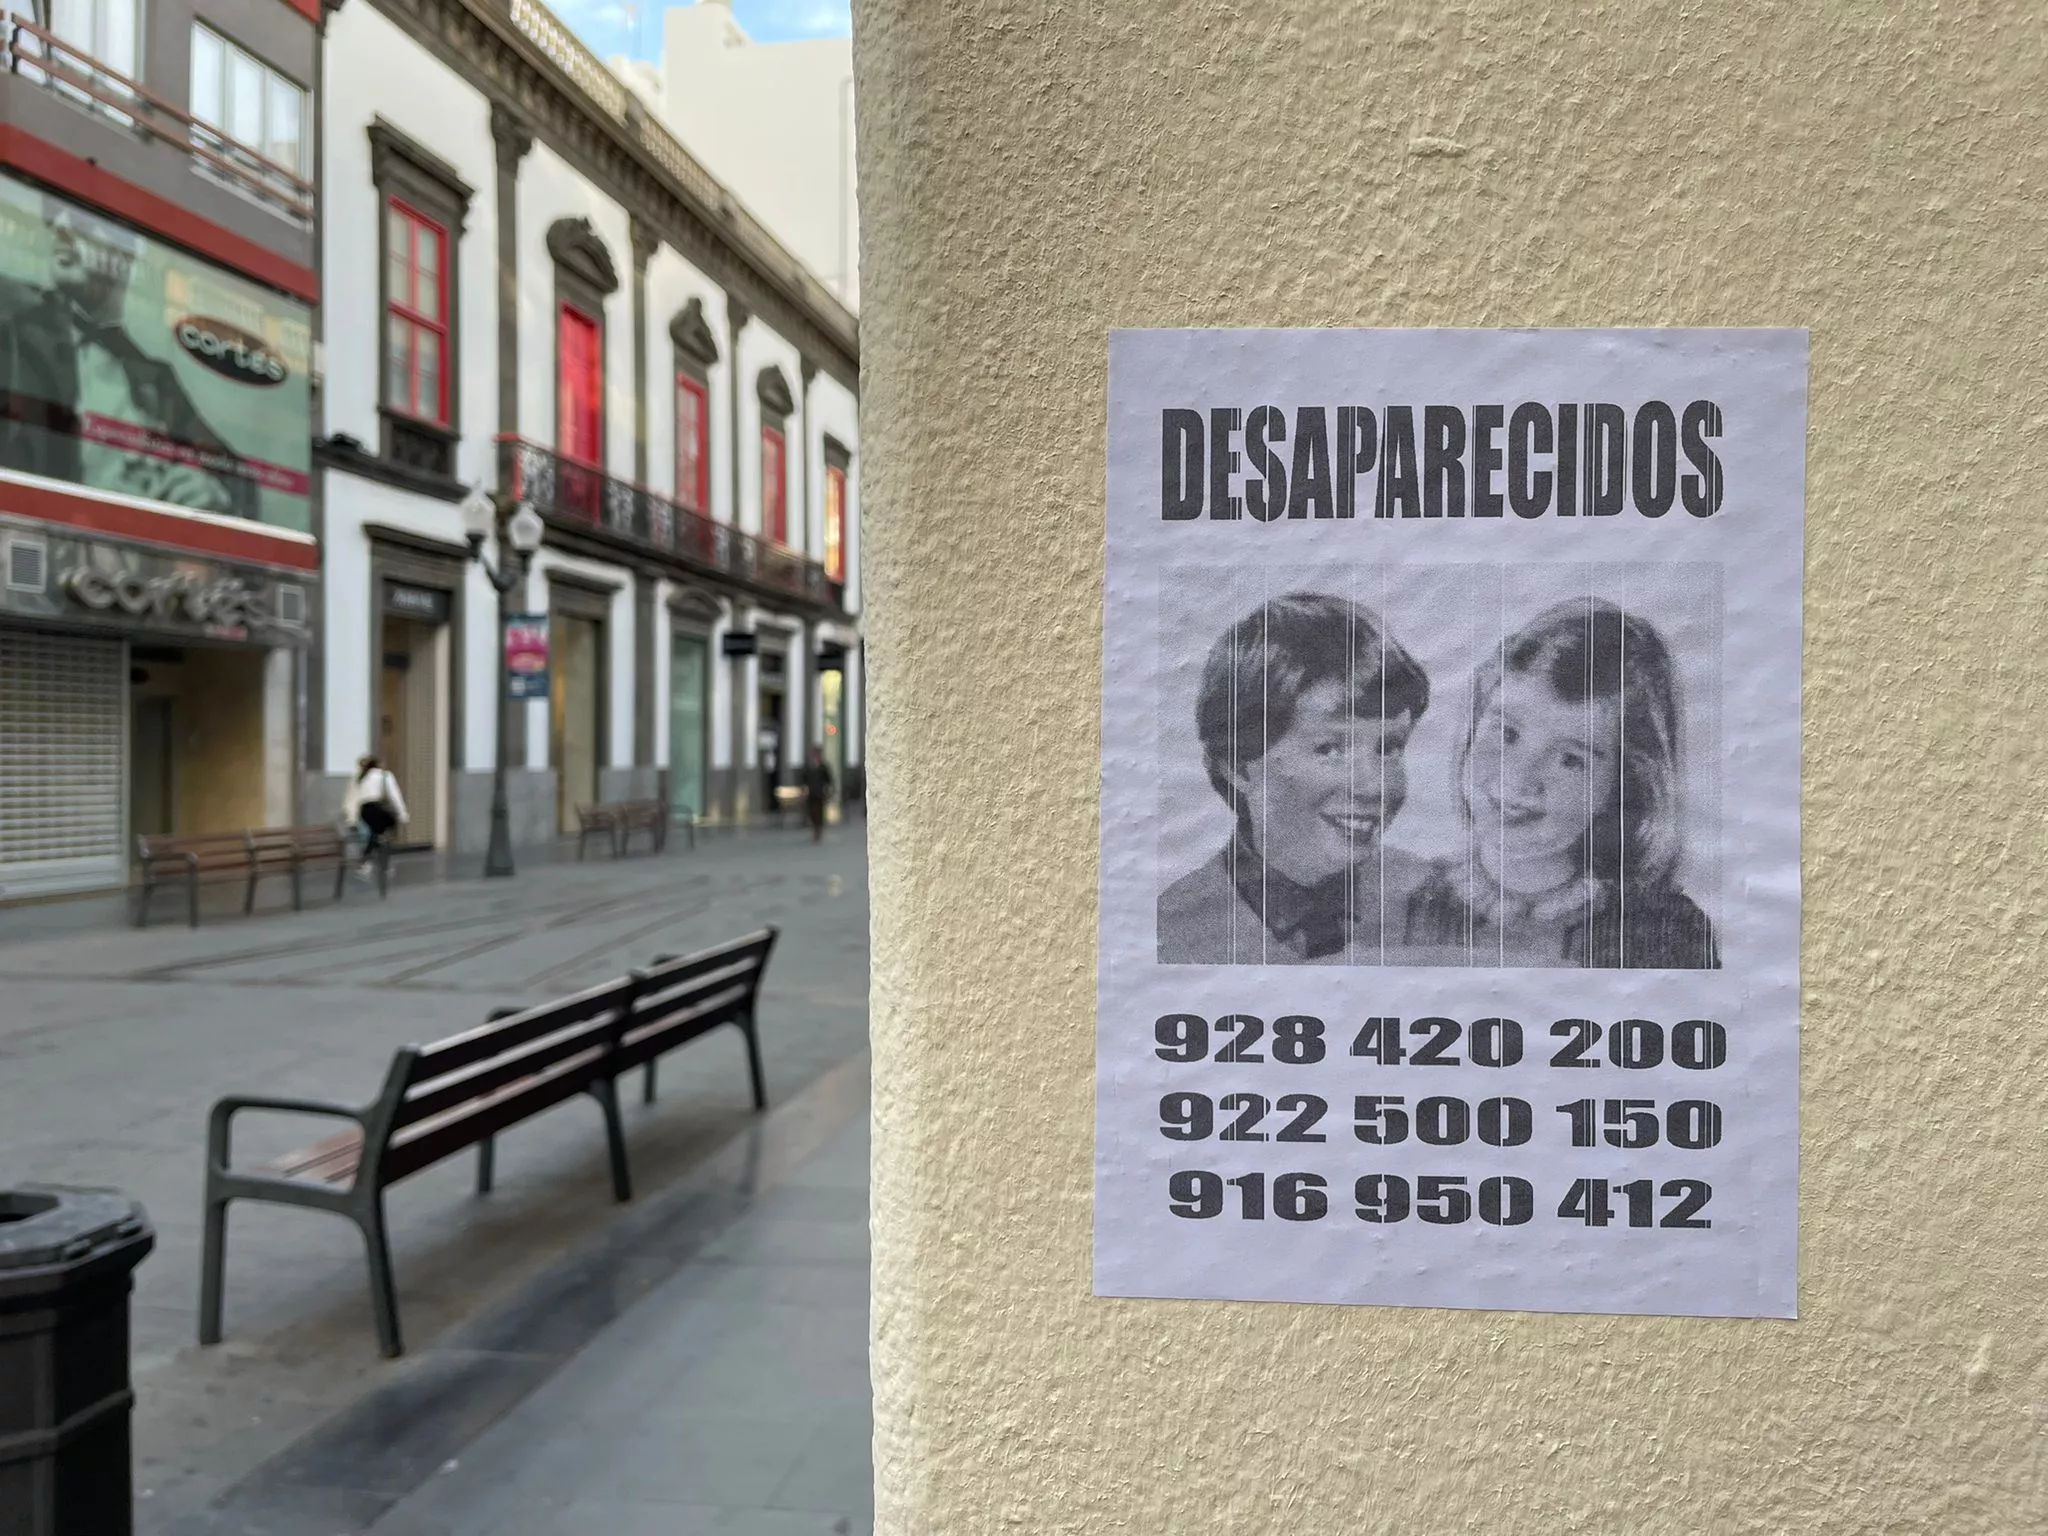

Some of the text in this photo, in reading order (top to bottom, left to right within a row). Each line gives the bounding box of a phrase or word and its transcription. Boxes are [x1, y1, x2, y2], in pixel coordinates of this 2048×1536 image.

[1162, 400, 1724, 523] DESAPARECIDOS
[1154, 1013, 1727, 1071] 928 420 200
[1160, 1091, 1722, 1150] 922 500 150
[1169, 1170, 1713, 1229] 916 950 412
